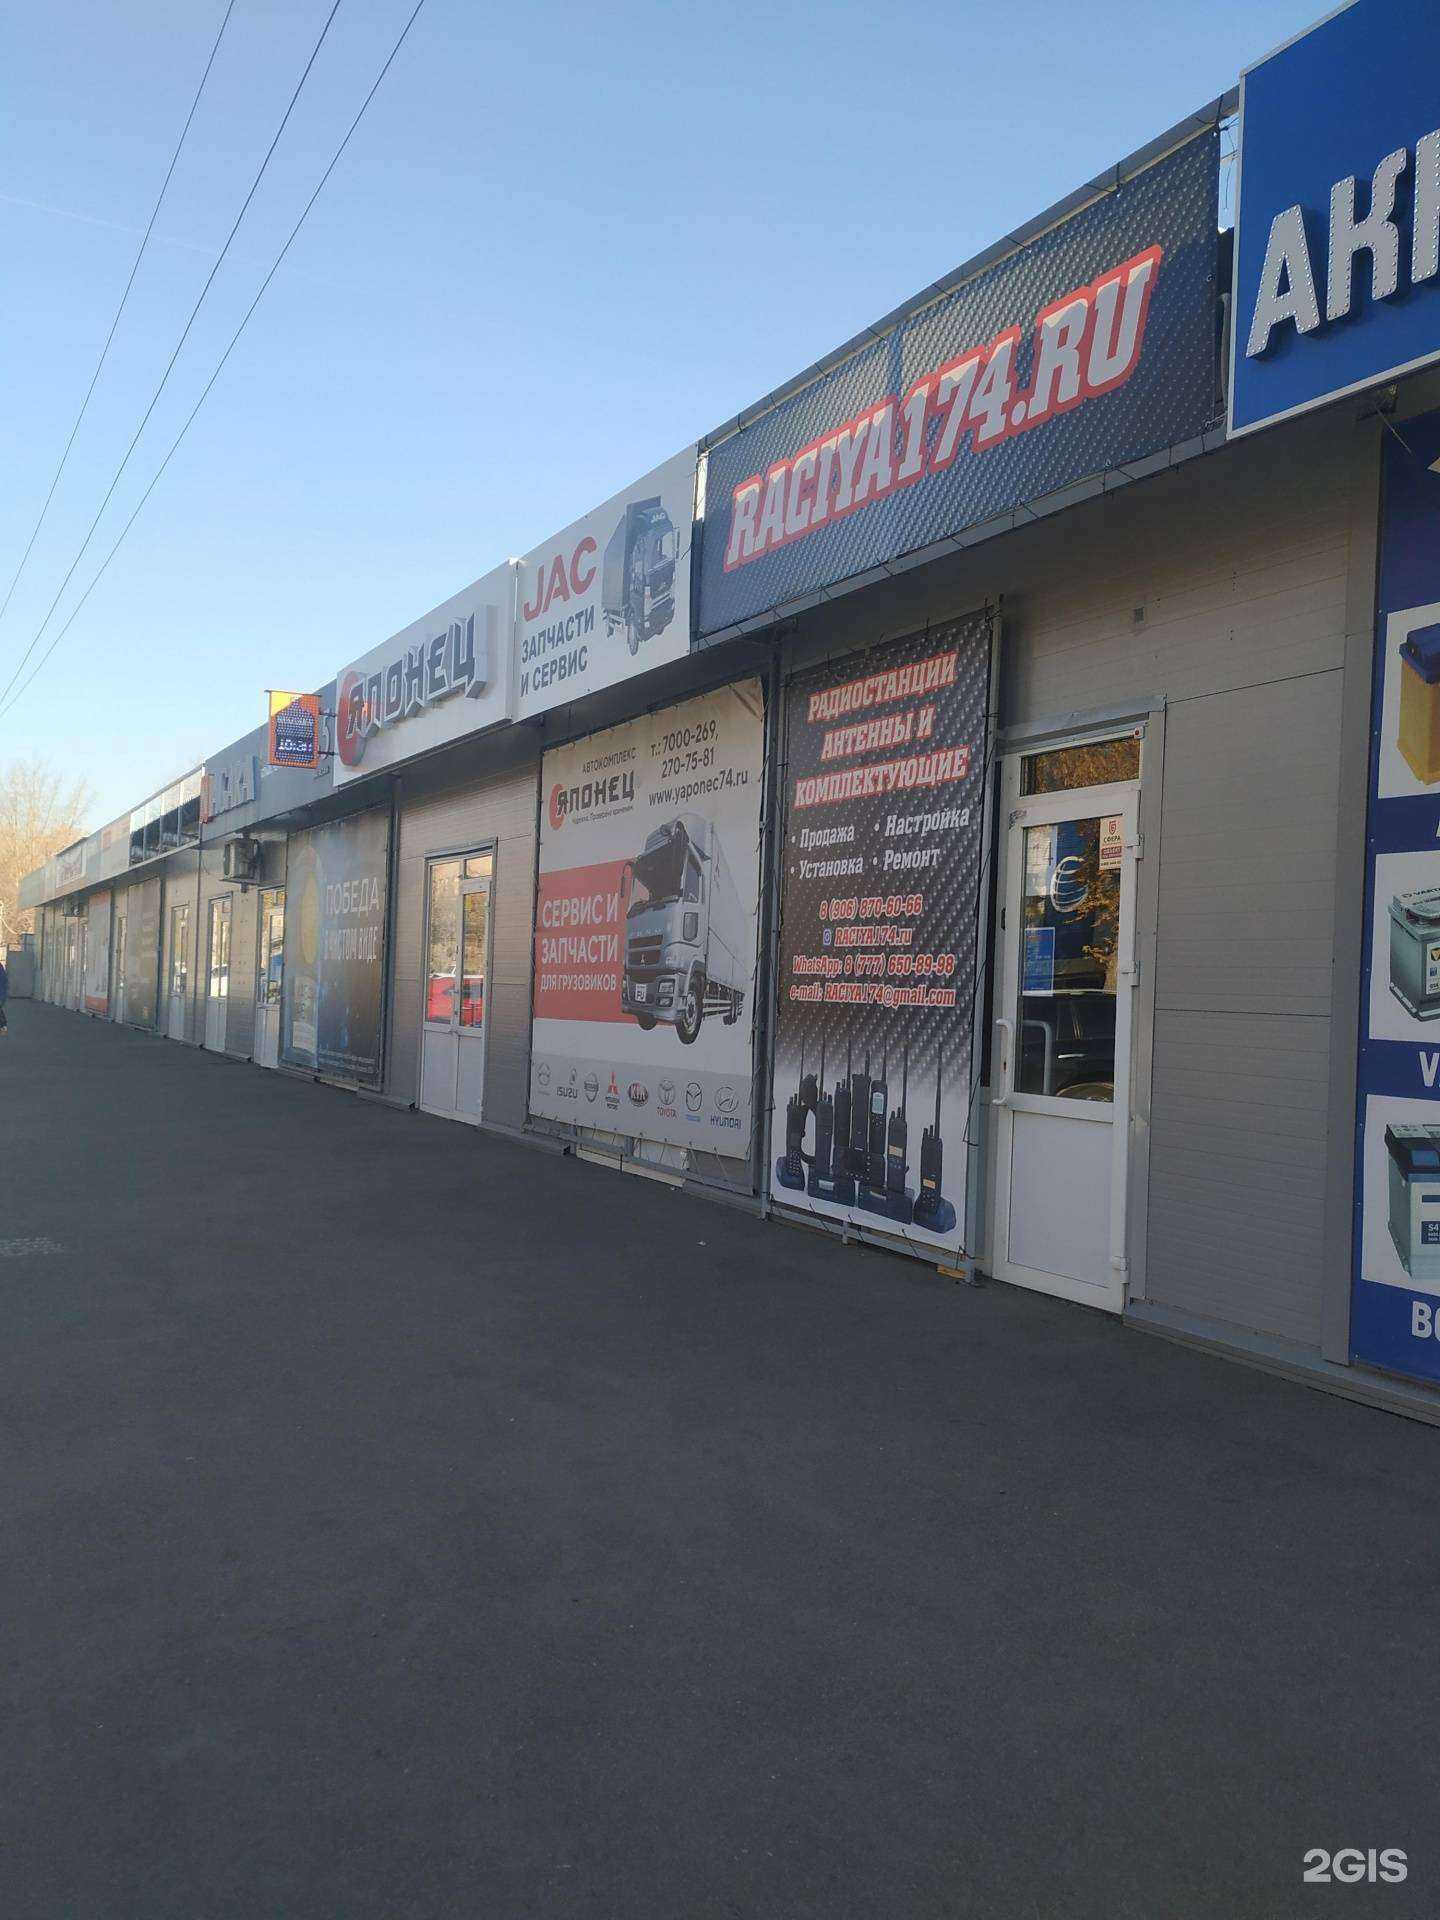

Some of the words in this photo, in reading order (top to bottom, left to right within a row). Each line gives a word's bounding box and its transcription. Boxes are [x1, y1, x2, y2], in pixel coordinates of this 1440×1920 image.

[725, 250, 1158, 568] RACIYA174.RU
[523, 536, 597, 622] JAC
[521, 605, 595, 664] ЗАПЧАСТИ
[520, 672, 529, 697] И
[533, 646, 588, 691] СЕРВИС
[808, 653, 957, 722] РАДИОСТАНЦИИ
[821, 714, 913, 760] АНТЕННЫ
[917, 707, 934, 738] И
[582, 747, 637, 774] АВТОКОМПЛЕКС
[661, 748, 716, 778] 270-75-81
[648, 767, 748, 806] www.yaponec74.ru
[795, 746, 969, 808] КОМПЛЕКТУЮЩИЕ
[556, 770, 635, 816] ЯПОНЕЦ
[885, 807, 970, 837] Настройка
[800, 825, 855, 851] Продажа
[800, 857, 863, 879] Установка
[883, 848, 940, 871] Ремонт
[326, 877, 379, 917] ПОБЕДА
[542, 896, 602, 928] СЕРВИС
[605, 893, 618, 922] И
[819, 900, 828, 920] 8
[829, 897, 857, 921] (906)
[859, 895, 923, 918] 870-60-66
[541, 934, 618, 965] ЗАПЧАСТИ
[834, 926, 912, 947] RACIYA174.ru
[793, 956, 842, 978] WhatsApp:
[843, 956, 852, 975] 8
[854, 955, 884, 976] (777)
[887, 954, 955, 976] 650-89-98
[540, 974, 557, 993] ДЛЯ
[558, 973, 617, 991] ГРУЗОВИКОВ
[790, 984, 822, 1000] e-mail:
[556, 1086, 578, 1099] ISUZU
[710, 1115, 742, 1129] HYUNDAI
